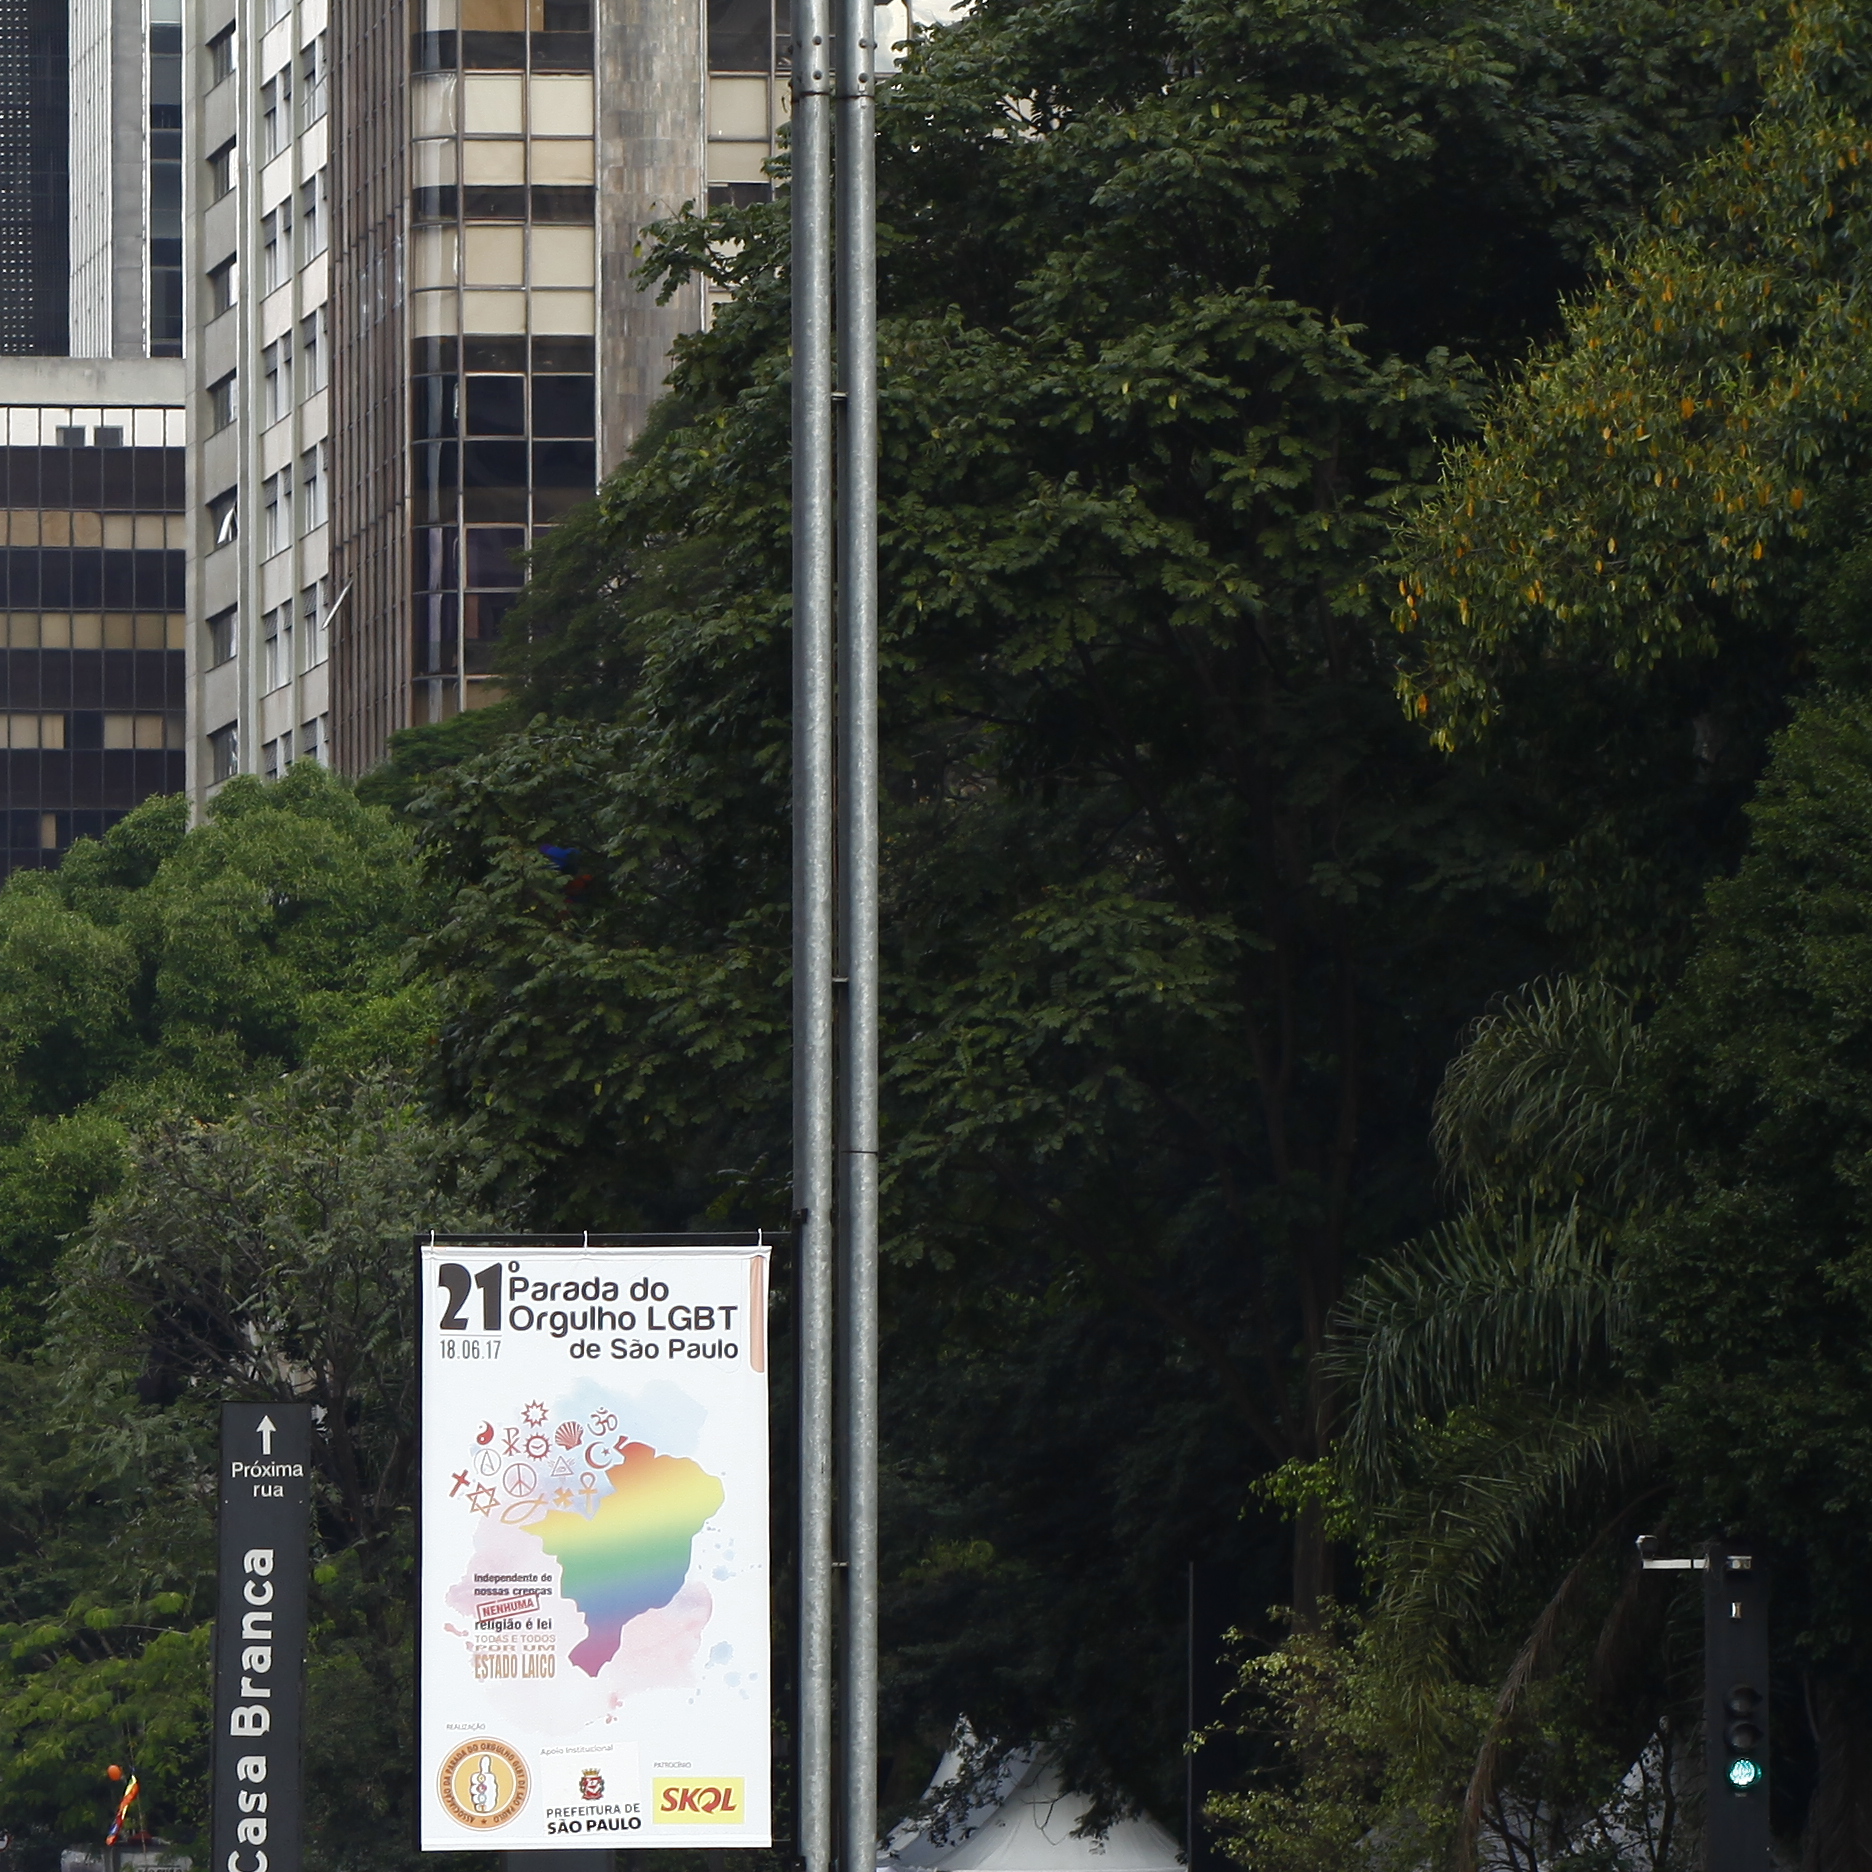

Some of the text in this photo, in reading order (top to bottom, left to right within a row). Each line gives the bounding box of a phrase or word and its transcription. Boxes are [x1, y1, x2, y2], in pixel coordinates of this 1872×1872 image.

[509, 1277, 669, 1301] Parada do
[509, 1305, 738, 1338] Orgulho LGBT
[439, 1340, 501, 1360] 18.06.17
[569, 1338, 738, 1360] de São Paulo
[231, 1460, 304, 1478] Próxima
[253, 1484, 285, 1498] rua
[474, 1573, 537, 1585] Independente
[474, 1588, 510, 1597] nossas
[481, 1599, 535, 1618] NENHUMA
[475, 1617, 552, 1633] religião é lei
[230, 1548, 274, 1736] Branca
[475, 1633, 556, 1644] TODAS E TODOS
[474, 1653, 555, 1680] ESTADO LAICO
[660, 1786, 737, 1814] SKOL
[546, 1803, 641, 1818] PREFEITURA DE
[547, 1816, 642, 1835] SÃO PAULO
